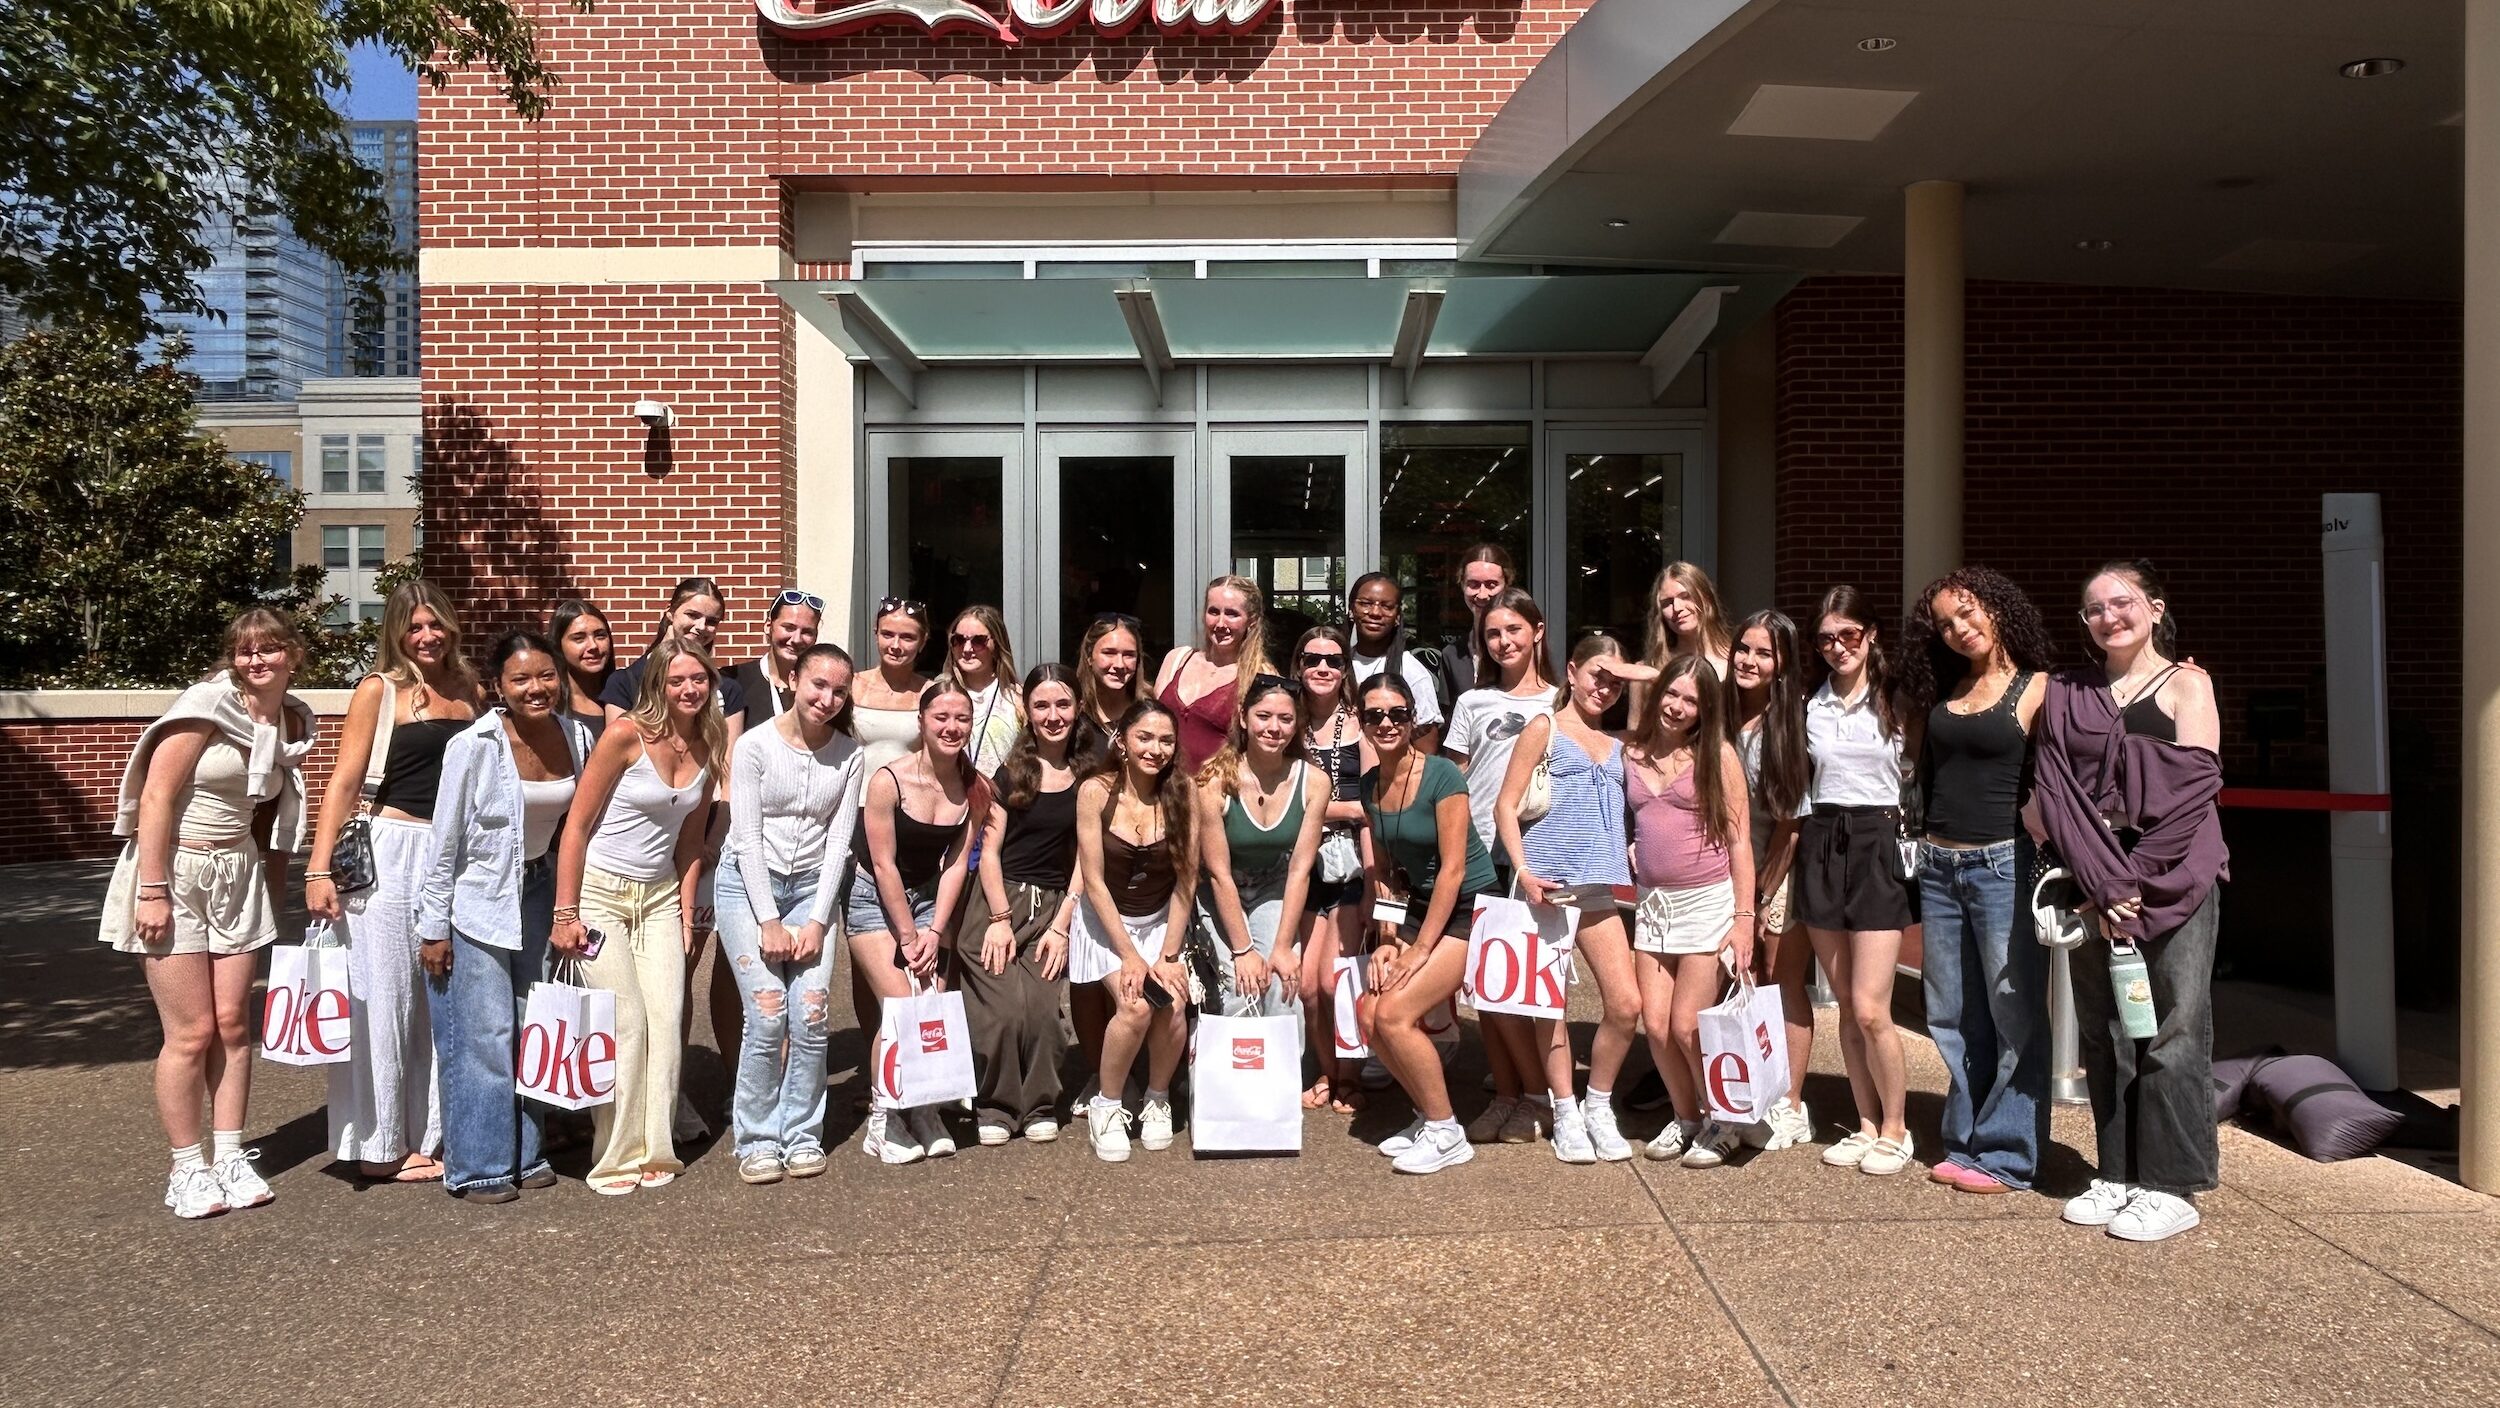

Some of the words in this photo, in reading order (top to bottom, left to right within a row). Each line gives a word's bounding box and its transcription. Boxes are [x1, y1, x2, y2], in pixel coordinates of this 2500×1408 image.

[1466, 908, 1571, 1009] ok
[262, 978, 351, 1056] oke
[517, 1018, 616, 1101] oke
[1702, 1052, 1754, 1114] e
